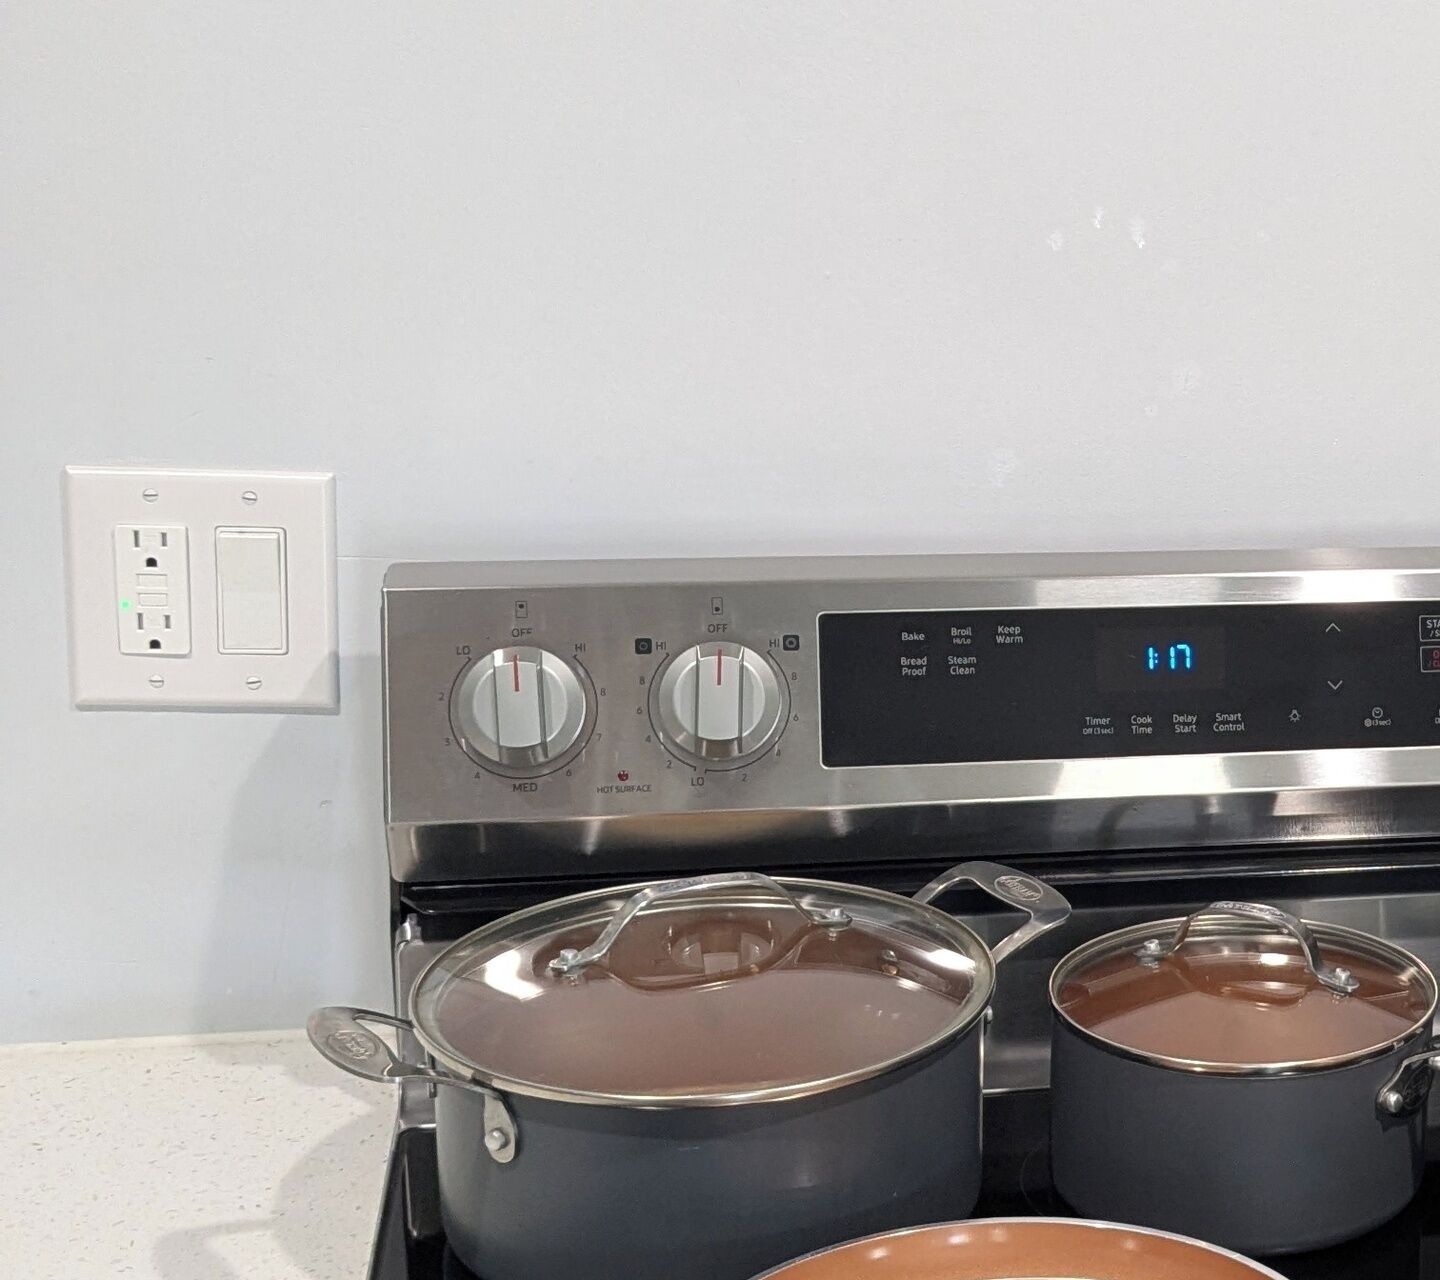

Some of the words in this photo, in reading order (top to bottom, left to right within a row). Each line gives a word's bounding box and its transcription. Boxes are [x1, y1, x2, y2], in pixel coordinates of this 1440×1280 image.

[511, 628, 533, 638] OFF
[707, 623, 728, 633] OFF
[951, 626, 972, 636] Broil
[997, 625, 1021, 635] Keep
[901, 632, 926, 641] Bake
[995, 635, 1024, 643] Warm
[575, 643, 586, 653] HI
[655, 641, 667, 651] HI
[769, 639, 780, 648] HI
[456, 646, 471, 656] LO
[900, 656, 927, 666] Bread
[947, 655, 977, 665] Steam
[1148, 644, 1191, 670] 1:17
[901, 666, 926, 676] Proof
[950, 666, 975, 675] Clean
[1085, 717, 1111, 725] Timer
[1131, 714, 1152, 724] Cook
[1172, 714, 1197, 724] Delay
[1215, 712, 1242, 721] Smart
[1131, 725, 1152, 734] Time
[1174, 724, 1197, 733] Start
[1213, 721, 1245, 732] Control
[690, 777, 705, 787] LO
[512, 783, 538, 792] MED
[597, 786, 614, 794] HOT
[615, 785, 652, 794] SURFACE
